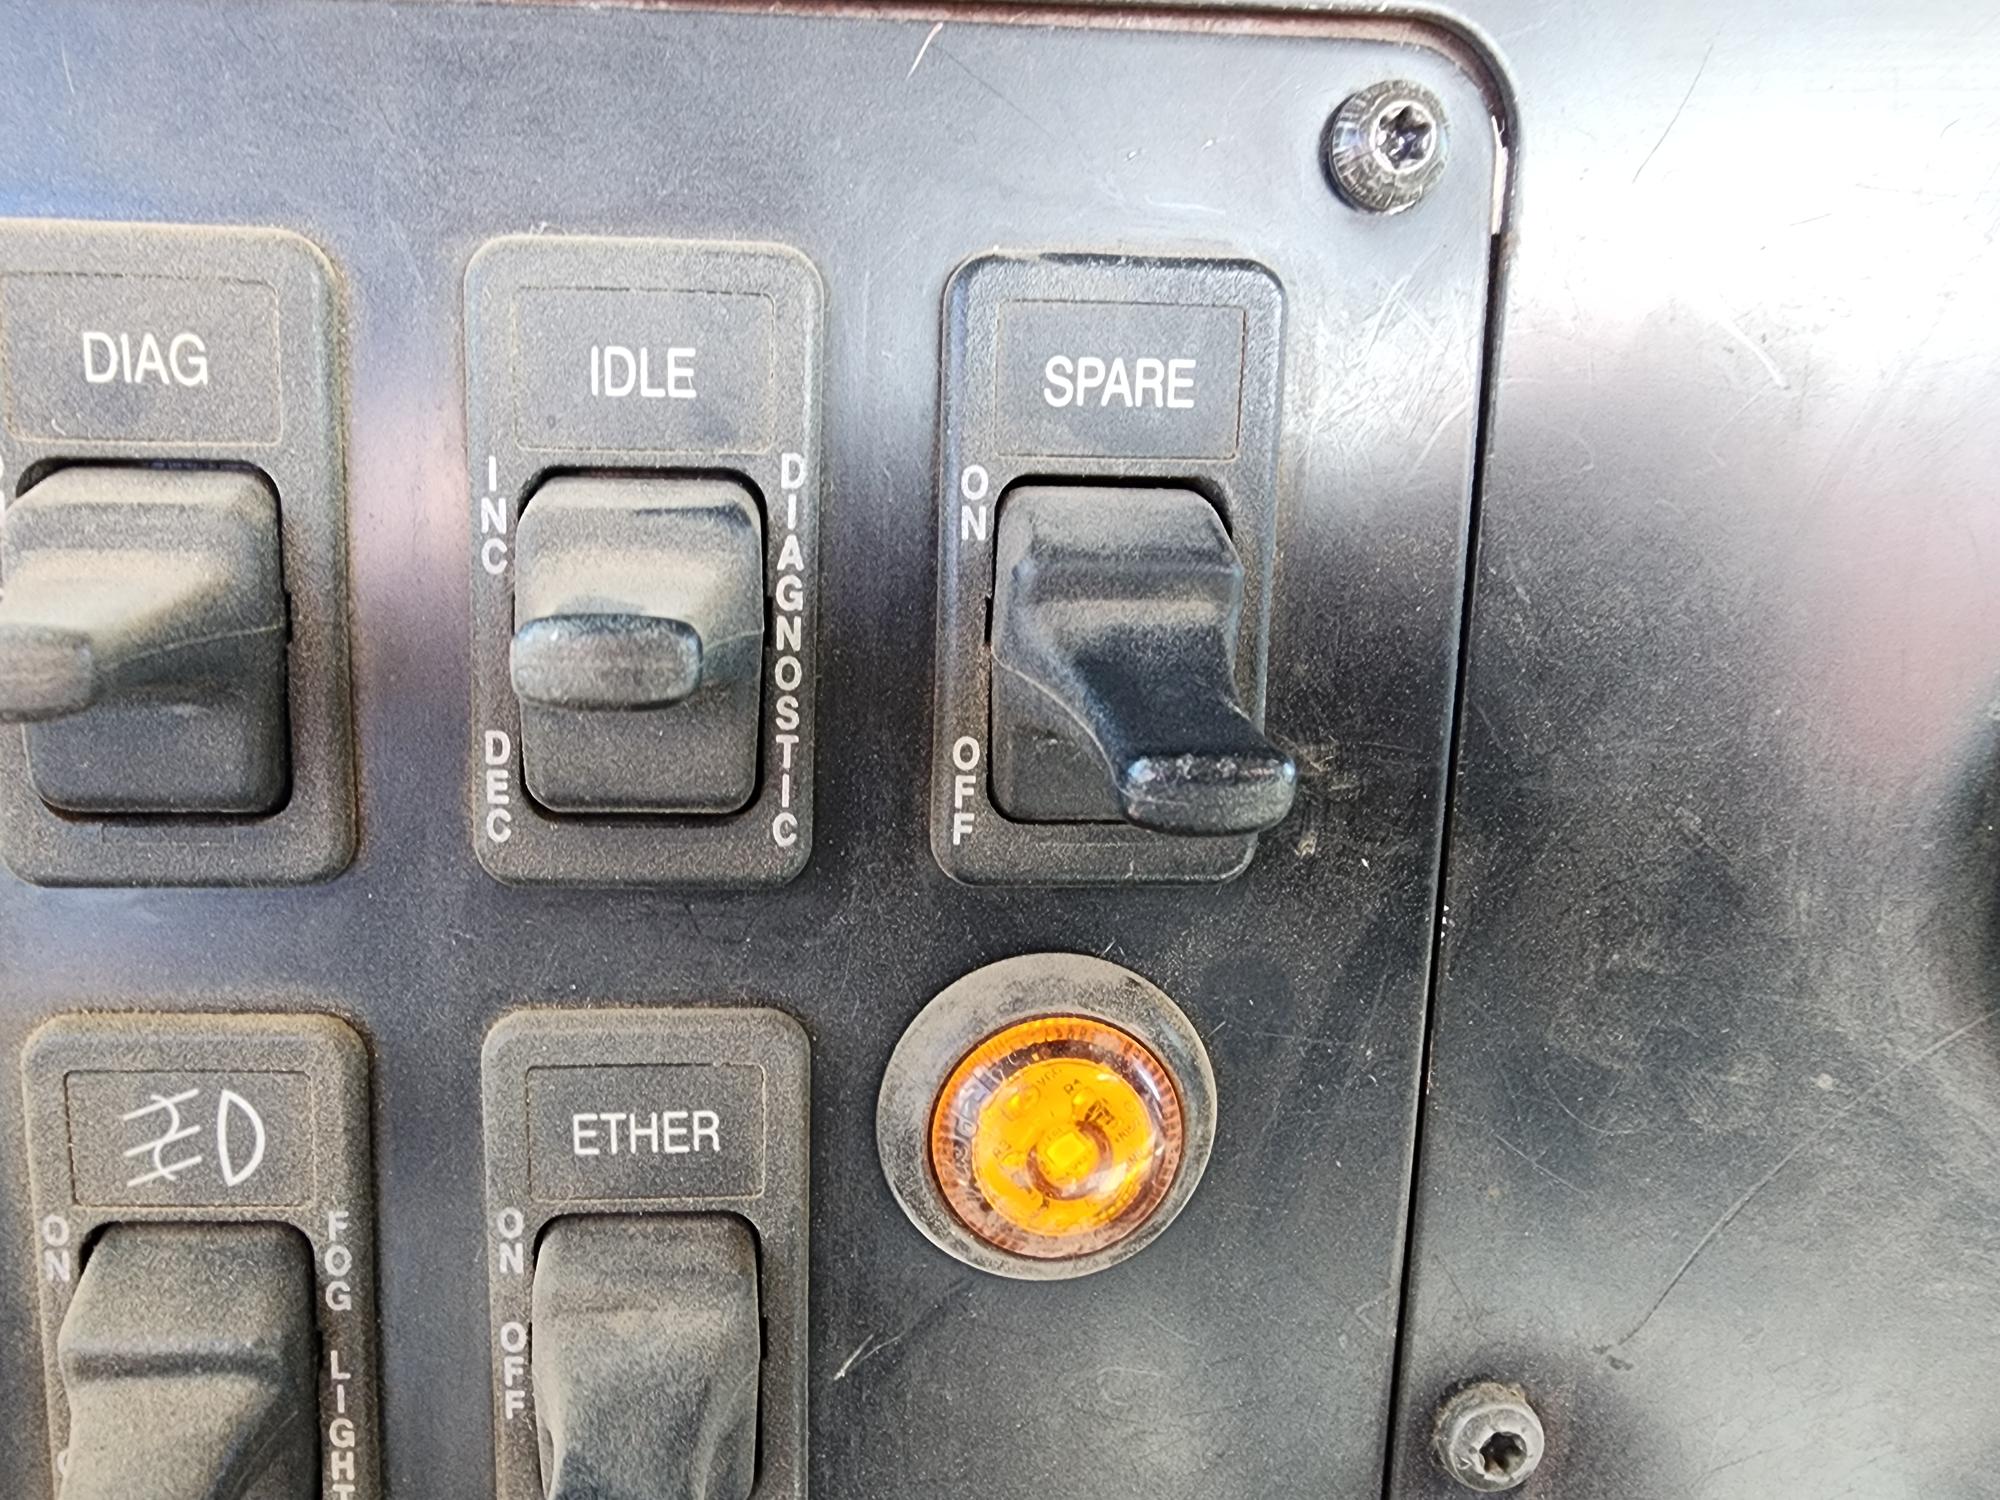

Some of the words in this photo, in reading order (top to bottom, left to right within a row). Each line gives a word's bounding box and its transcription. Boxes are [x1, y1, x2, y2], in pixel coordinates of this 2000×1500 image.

[81, 330, 209, 388] DIAG
[590, 345, 698, 400] IDLE
[1043, 354, 1198, 410] SPARE
[480, 455, 507, 576] INC
[961, 464, 987, 542] ON
[773, 453, 807, 848] DIAGNOSTIC
[484, 730, 512, 844] DEC
[952, 735, 981, 846] OFF
[572, 1109, 722, 1157] ETHER
[41, 1213, 71, 1284] ON
[327, 1210, 353, 1312] FOG
[496, 1207, 526, 1275] ON
[499, 1321, 528, 1421] OFF
